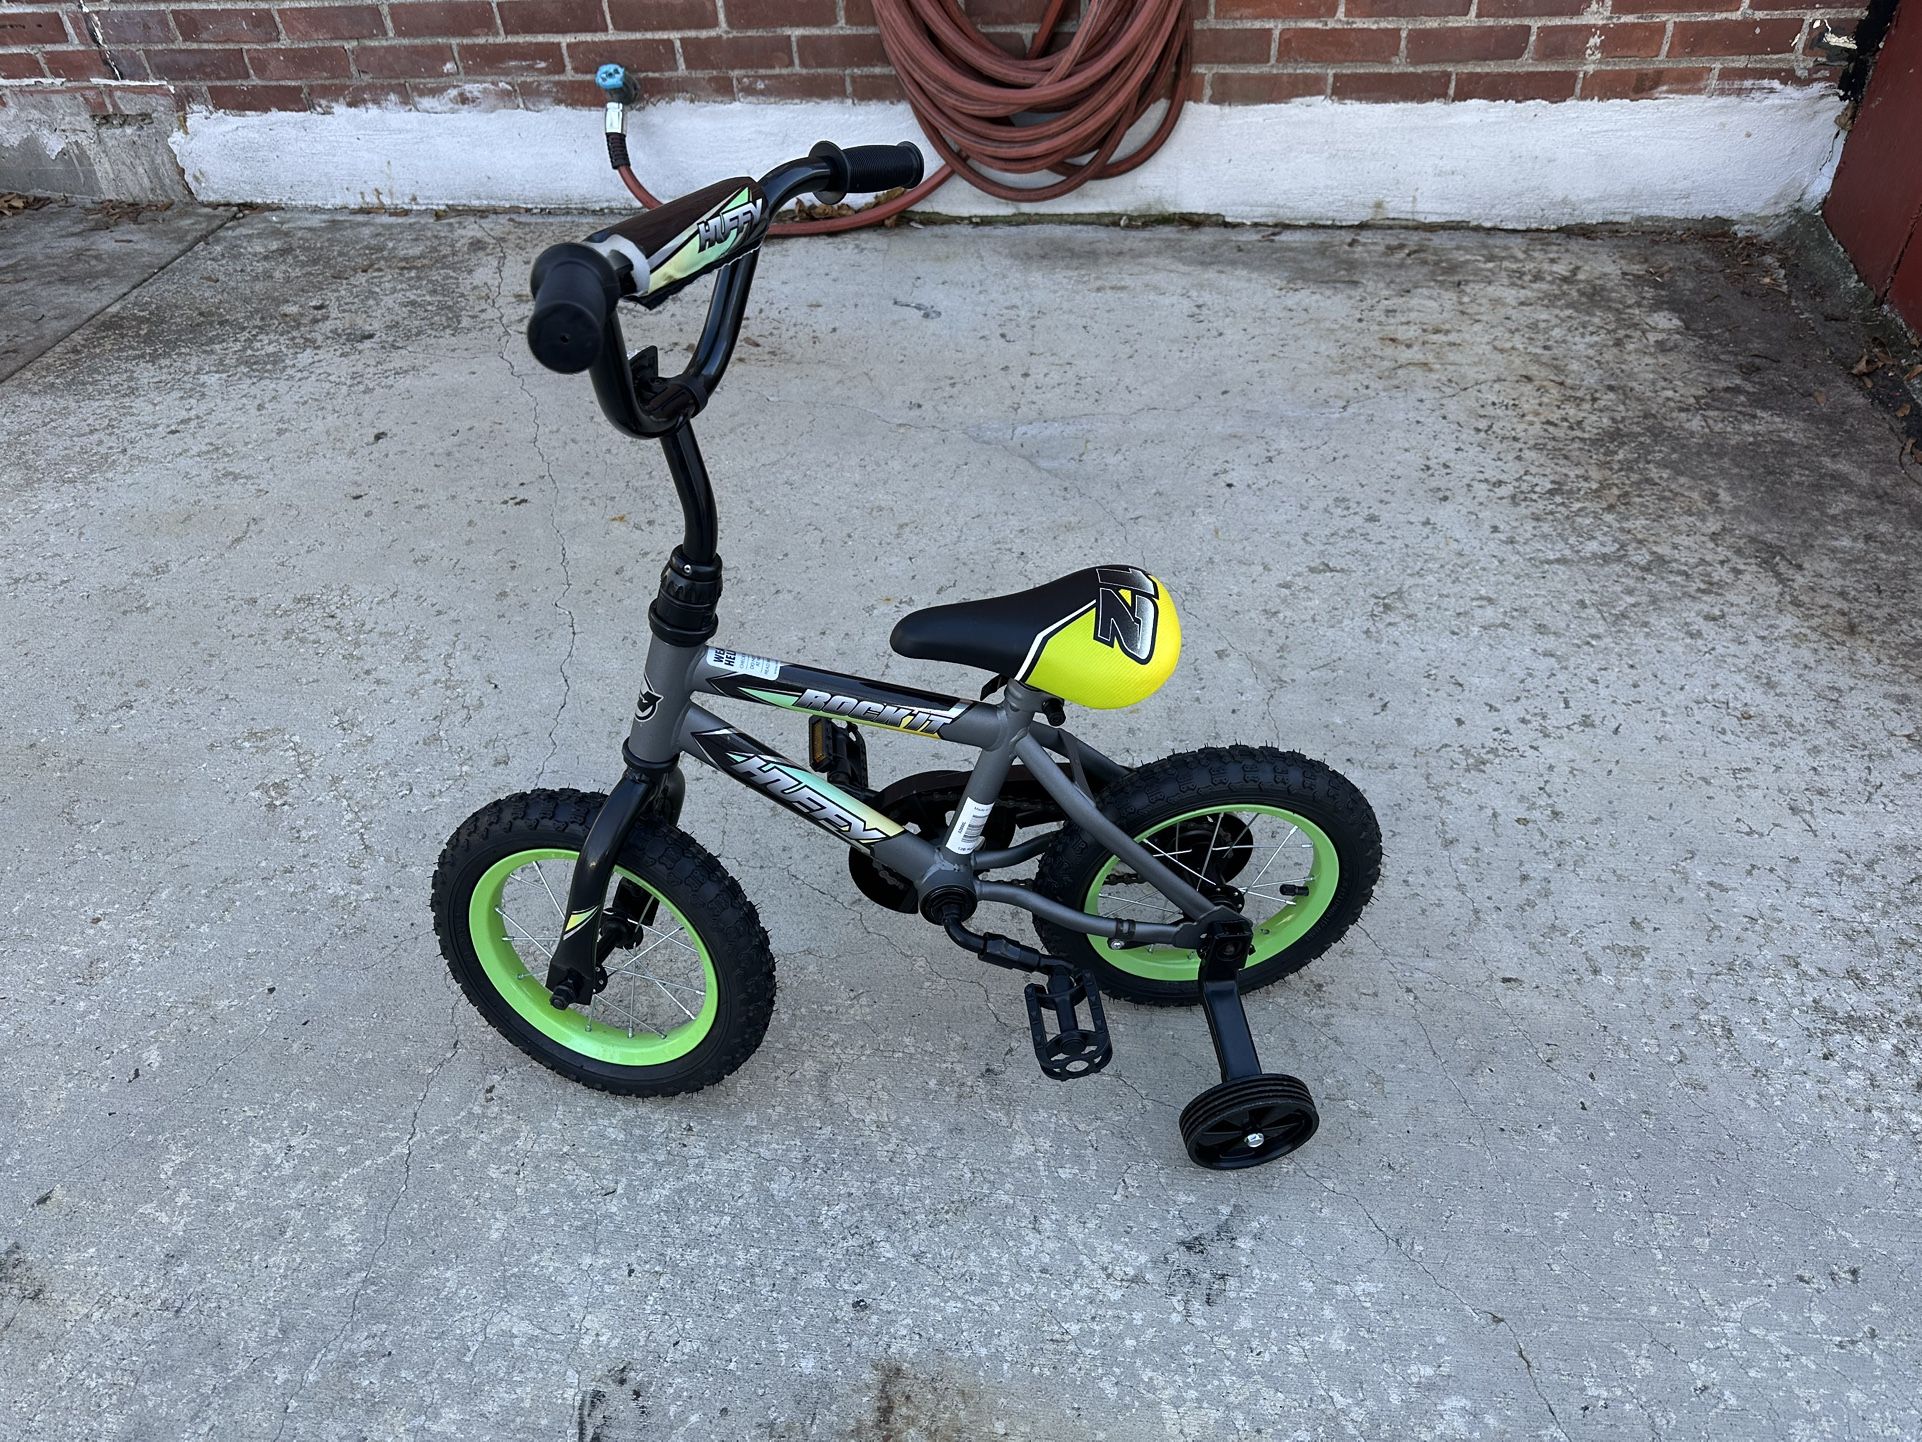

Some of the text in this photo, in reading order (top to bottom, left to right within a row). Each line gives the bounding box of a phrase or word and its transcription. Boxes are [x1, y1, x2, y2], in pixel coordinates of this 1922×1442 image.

[697, 199, 762, 252] HUFFY
[793, 688, 913, 728] ROCK
[730, 755, 887, 840] HUFFY
